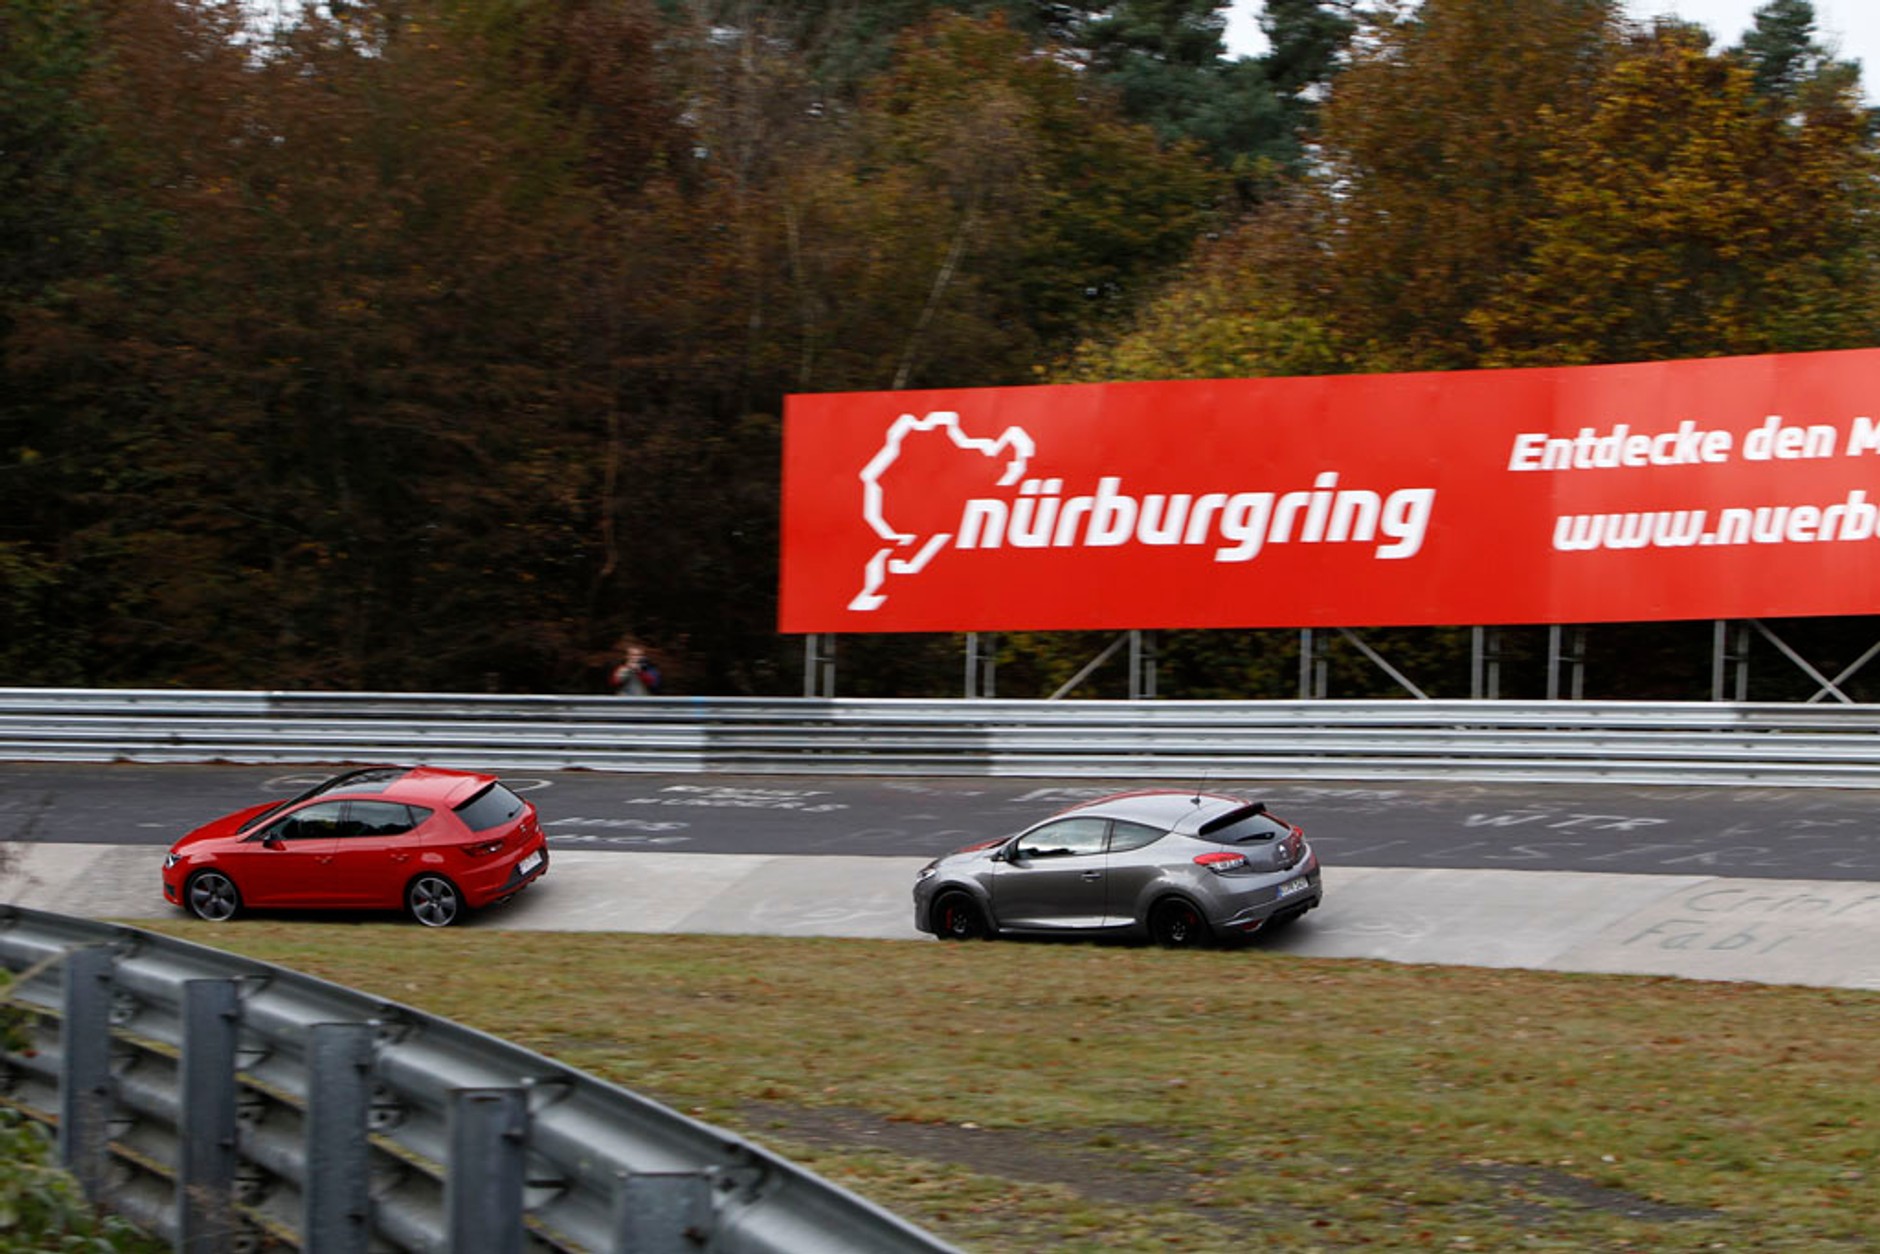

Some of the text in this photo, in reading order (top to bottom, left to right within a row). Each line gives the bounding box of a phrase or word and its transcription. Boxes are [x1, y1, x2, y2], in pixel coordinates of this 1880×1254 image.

[1508, 420, 1732, 471] Entdecke
[1743, 415, 1837, 460] den
[955, 472, 1436, 562] nürburgring
[1552, 490, 1880, 550] www.nuerb
